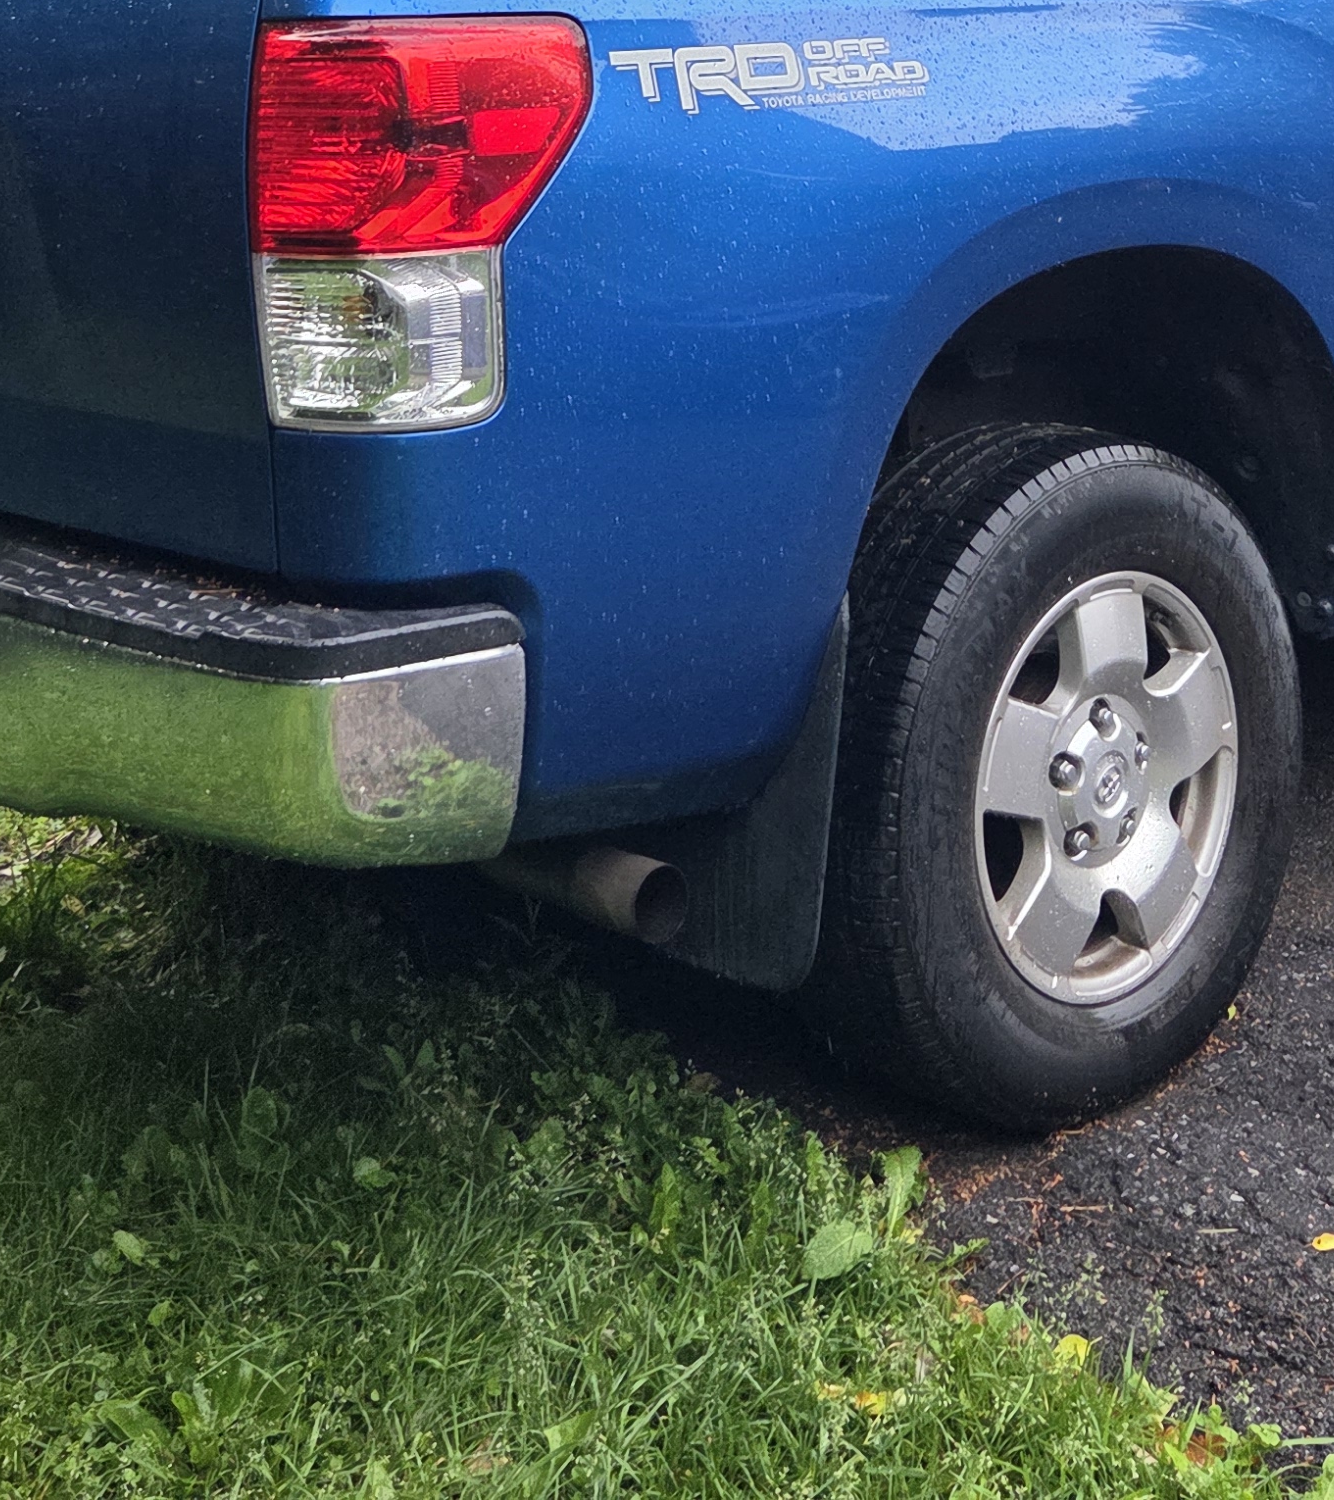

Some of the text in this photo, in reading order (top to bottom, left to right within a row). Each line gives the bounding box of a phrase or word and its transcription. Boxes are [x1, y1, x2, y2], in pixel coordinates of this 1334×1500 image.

[803, 36, 891, 62] OFF
[608, 42, 806, 115] TRD
[806, 61, 930, 90] ROAD
[761, 85, 927, 109] TOYOTA RACING DEVELOPMENT
